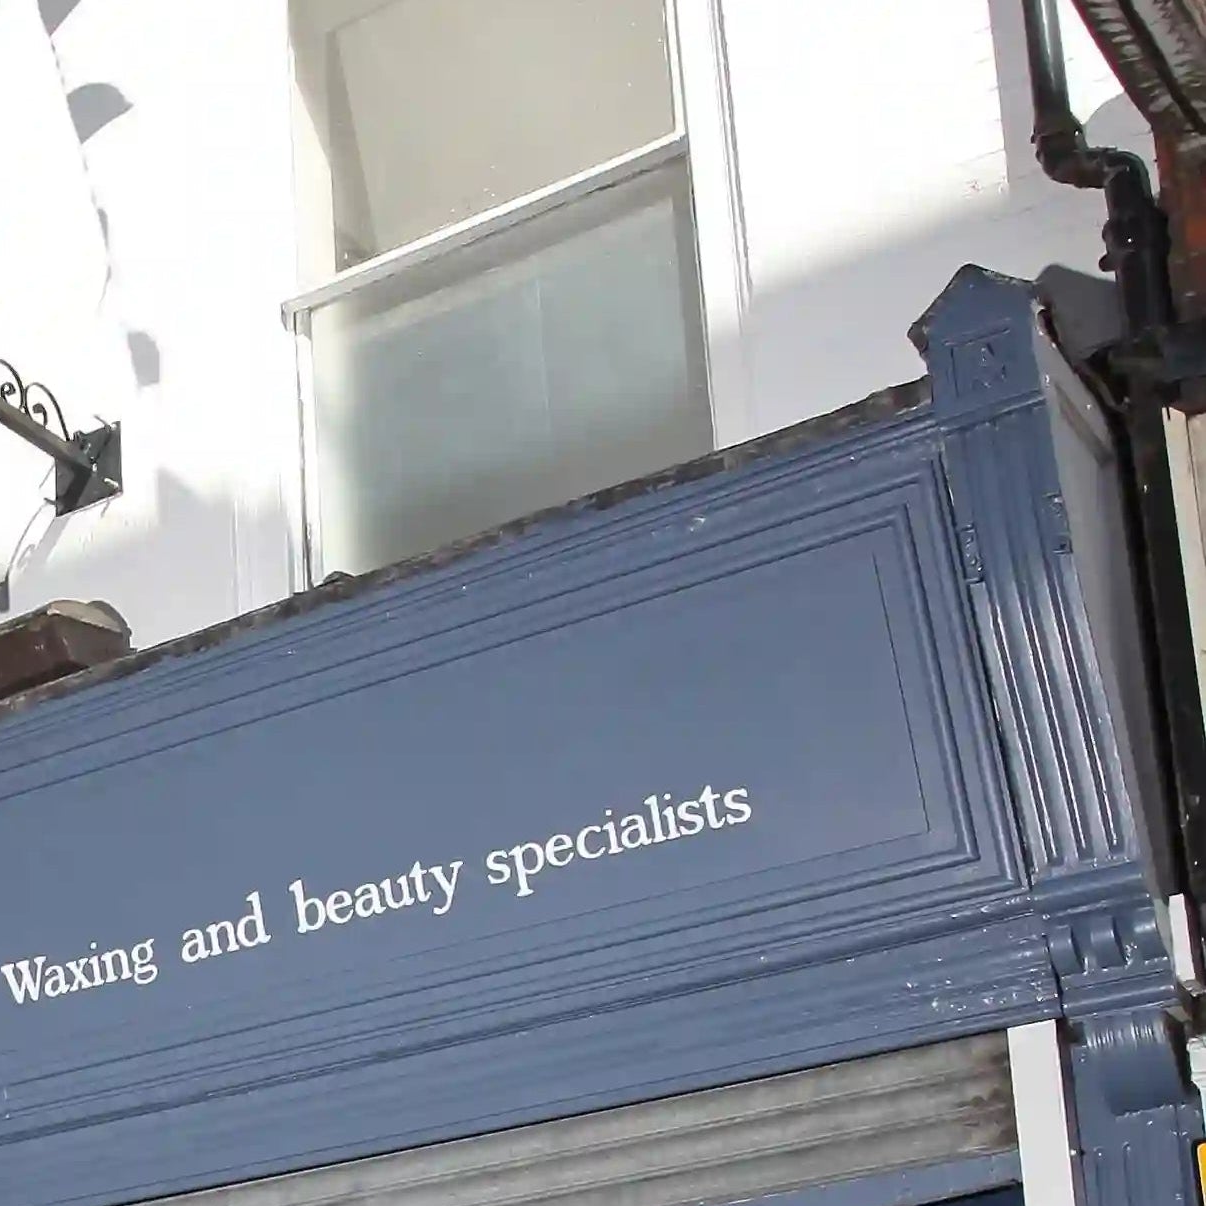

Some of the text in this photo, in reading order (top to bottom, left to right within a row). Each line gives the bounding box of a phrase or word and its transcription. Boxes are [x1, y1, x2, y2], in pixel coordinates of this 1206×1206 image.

[0, 784, 753, 1005] Waxing and beauty specialists
